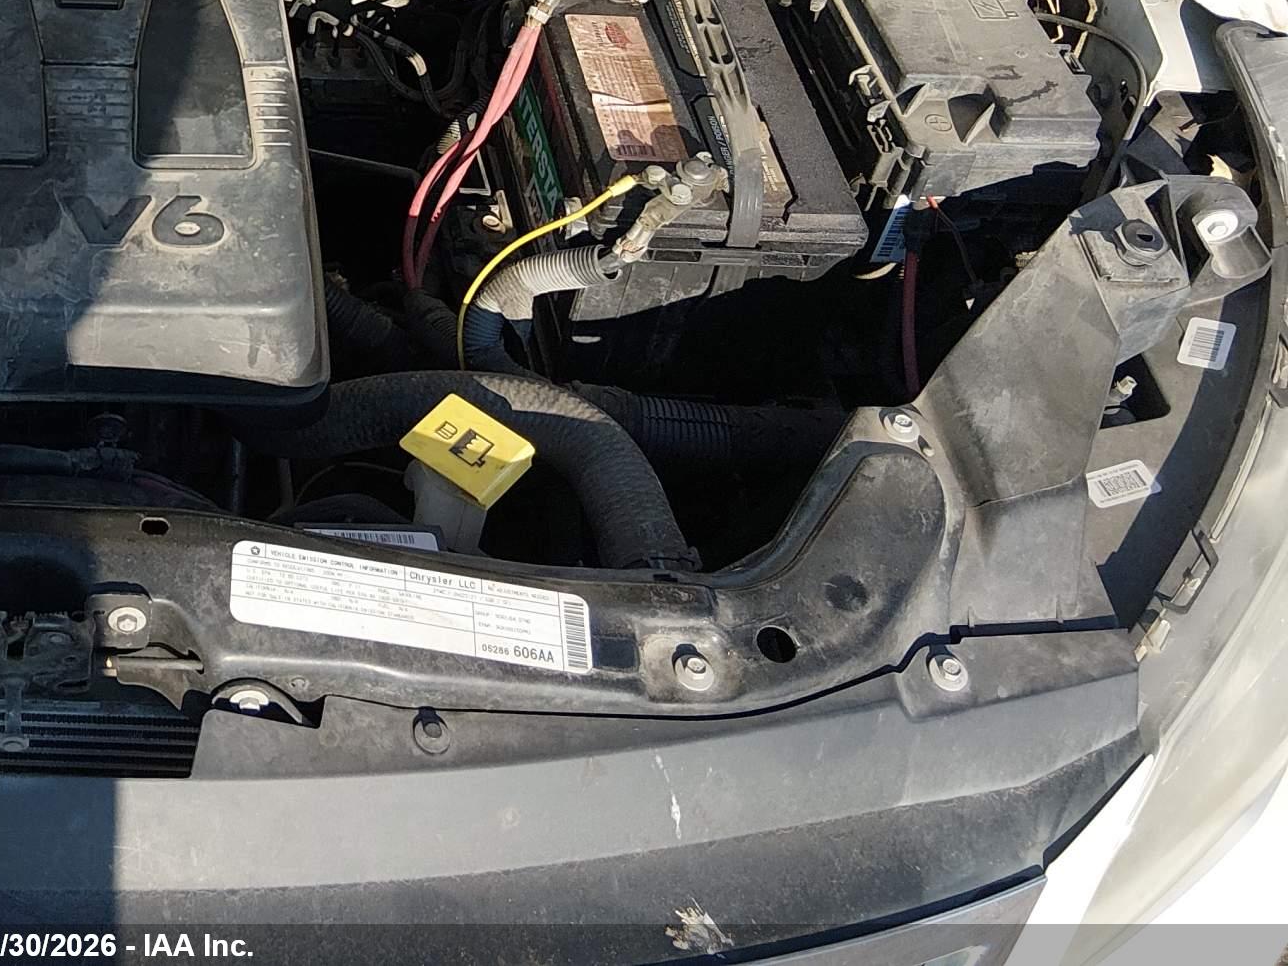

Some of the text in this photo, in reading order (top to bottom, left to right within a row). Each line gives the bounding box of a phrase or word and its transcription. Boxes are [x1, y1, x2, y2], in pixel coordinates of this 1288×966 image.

[58, 194, 225, 247] V6
[270, 549, 295, 559] VEHICLE
[298, 554, 327, 564] EMISSION
[330, 559, 353, 568] CONTROL
[359, 564, 398, 575] INFORMATION
[410, 571, 475, 589] Chrysler LLC
[513, 644, 554, 663] 606AA
